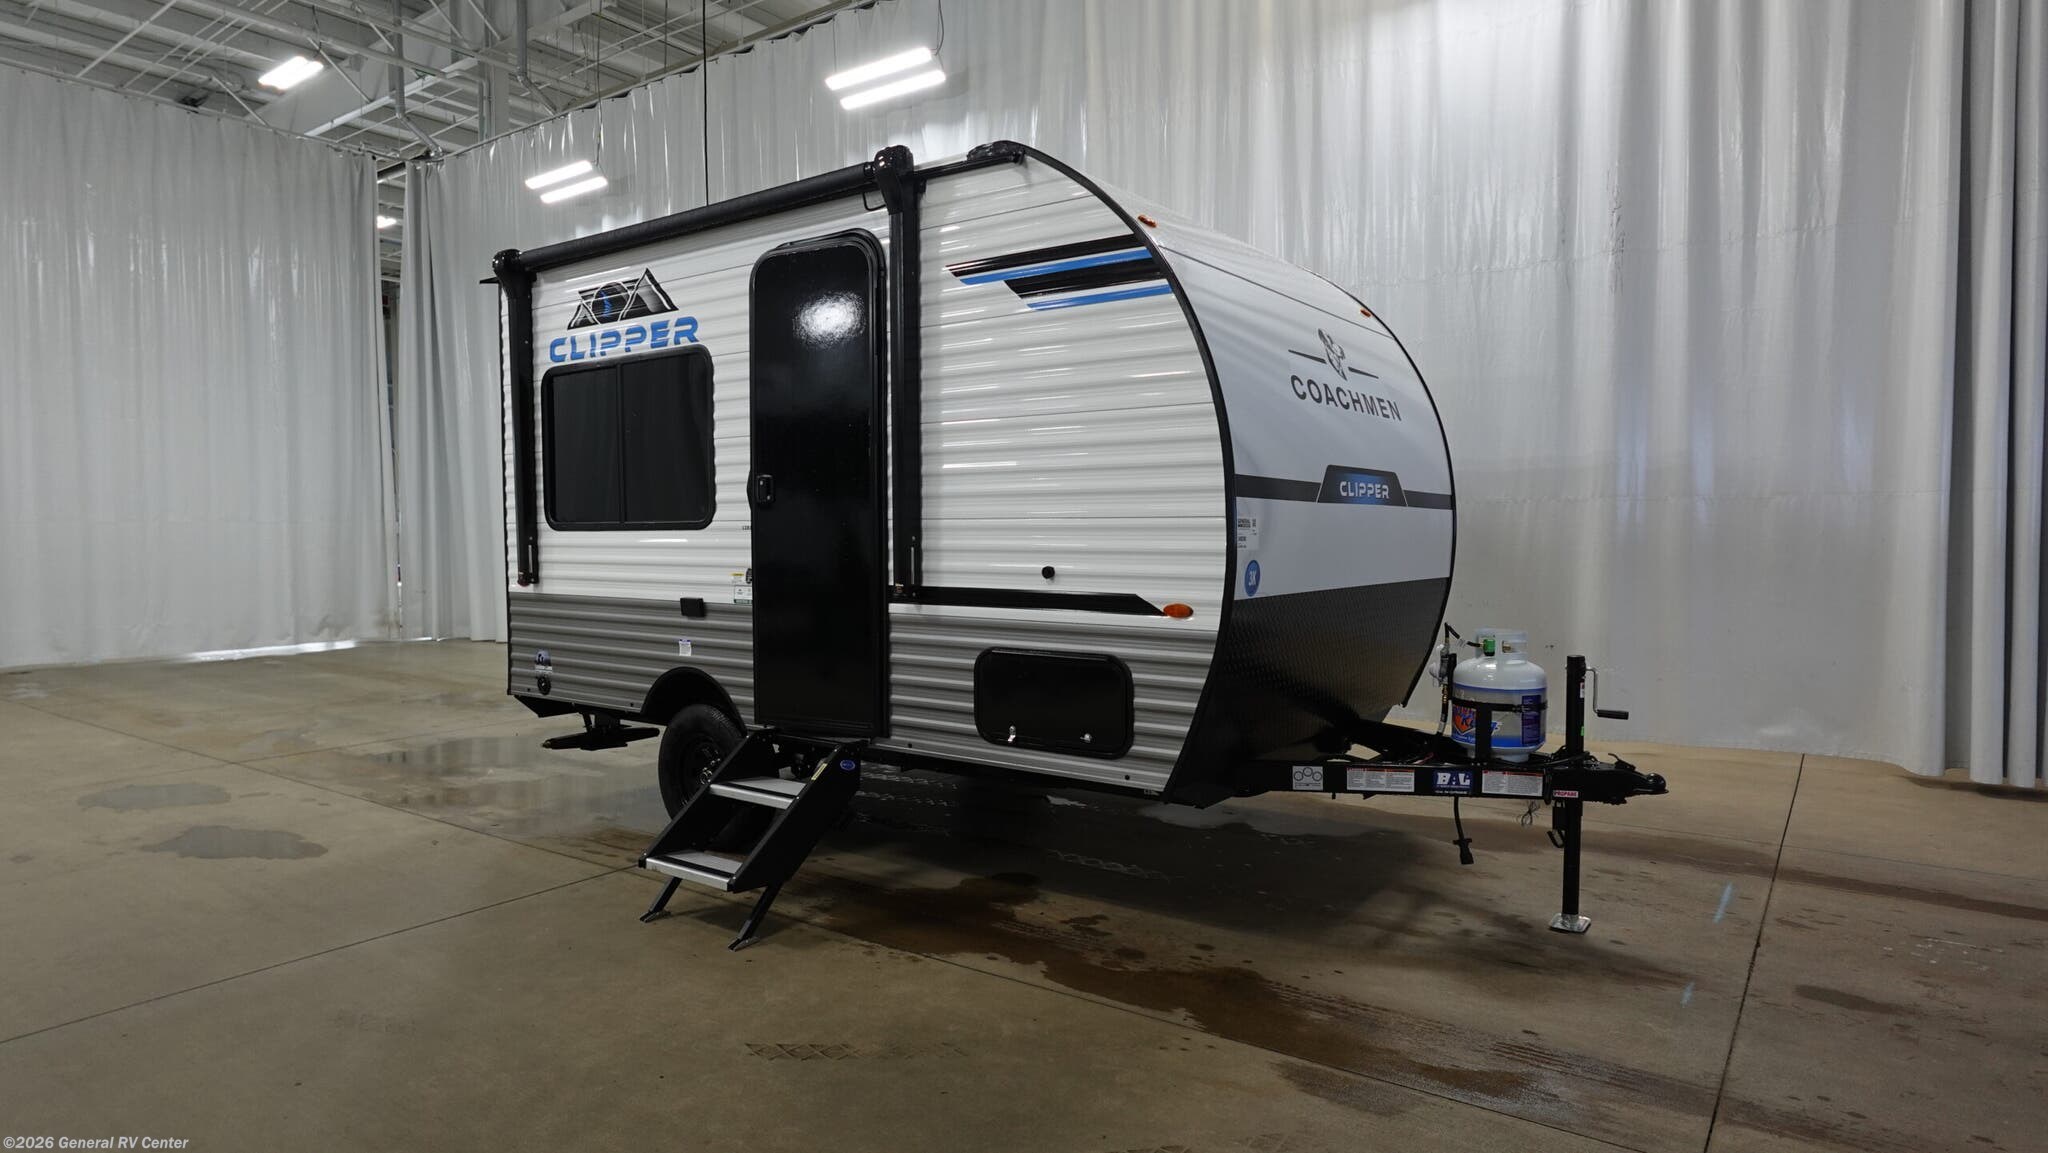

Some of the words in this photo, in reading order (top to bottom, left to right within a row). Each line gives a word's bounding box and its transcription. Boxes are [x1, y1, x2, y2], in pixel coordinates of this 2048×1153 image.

[549, 316, 699, 363] CLIPPER
[1290, 374, 1402, 421] COACHMEN
[1339, 480, 1390, 499] CLIPPER
